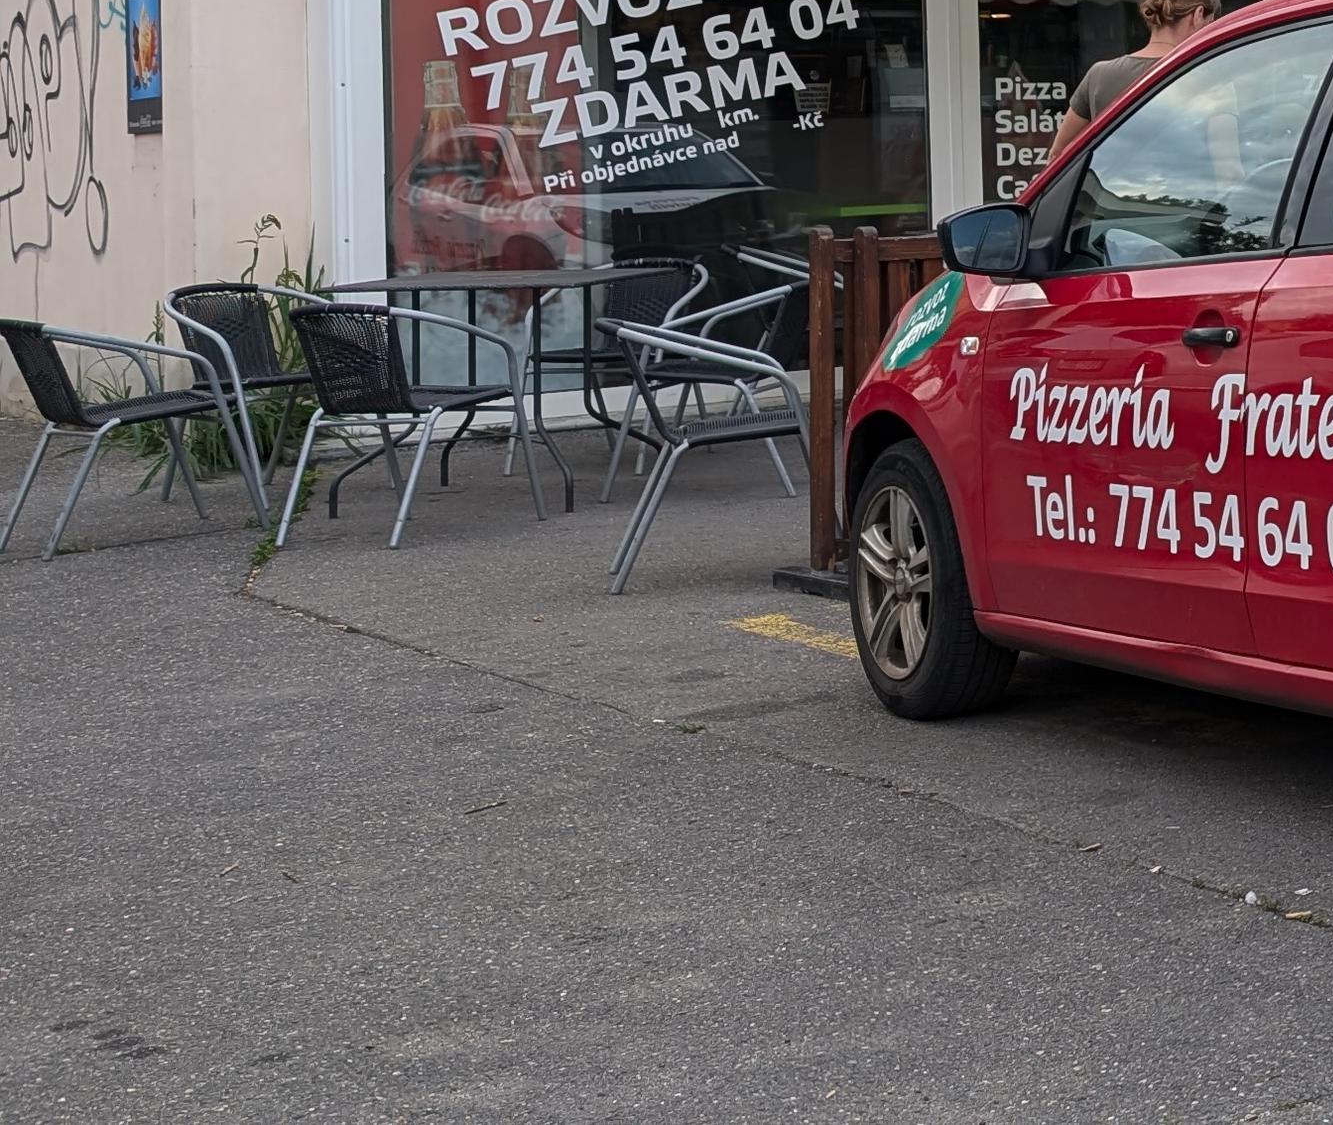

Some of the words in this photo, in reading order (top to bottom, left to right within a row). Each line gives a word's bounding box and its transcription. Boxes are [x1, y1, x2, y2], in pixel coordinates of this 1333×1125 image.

[470, 44, 595, 111] 774
[609, 25, 689, 82] 54
[702, 6, 776, 61] 64
[995, 76, 1067, 101] Pizza
[532, 51, 807, 150] ZDARMA
[589, 143, 605, 160] v
[610, 122, 694, 159] okruhu
[717, 106, 760, 129] km.
[543, 170, 577, 193] Při
[581, 142, 699, 185] objednávce
[701, 130, 741, 156] nad
[792, 111, 826, 132] -Kč
[888, 306, 947, 366] zdarma
[904, 281, 950, 332] rozvoz
[1009, 363, 1174, 450] Pizzeria
[1026, 474, 1095, 545] Tel.:
[1109, 482, 1181, 554] 774
[1192, 491, 1245, 564] 54
[1257, 497, 1313, 570] 64
